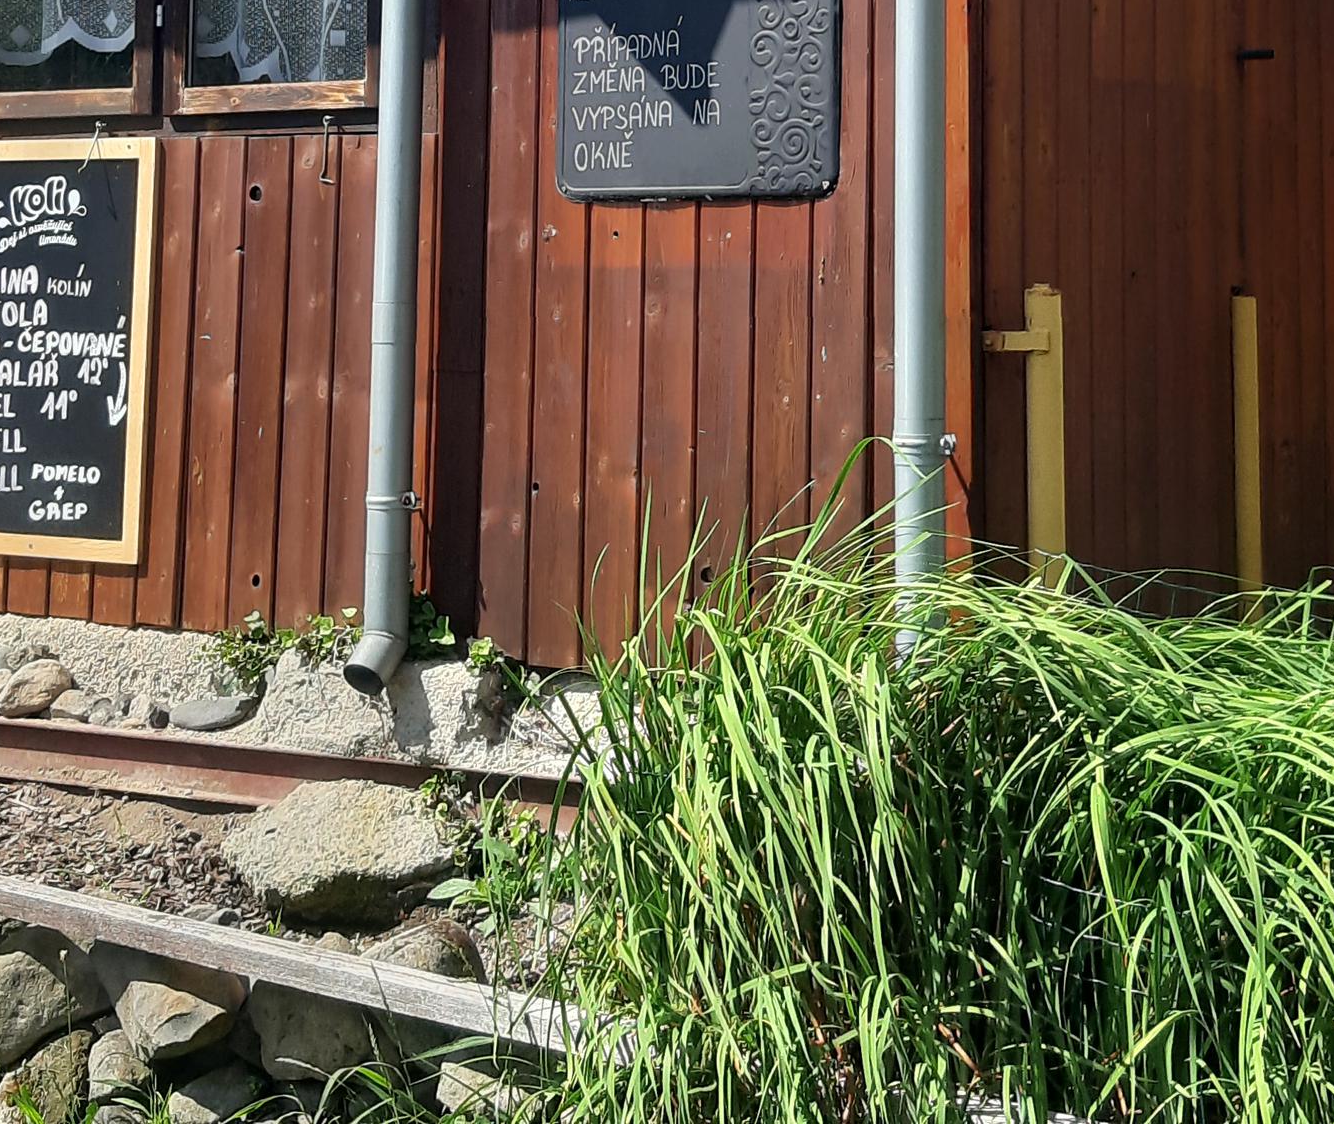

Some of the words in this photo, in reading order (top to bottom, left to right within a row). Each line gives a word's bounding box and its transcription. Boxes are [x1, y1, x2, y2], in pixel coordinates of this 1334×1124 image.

[572, 15, 683, 64] PŘÍPADNÁ
[572, 62, 645, 95] ZMĚNA
[660, 62, 720, 90] BUDE
[572, 95, 672, 131] VYPSÁNA
[693, 99, 720, 125] NA
[574, 131, 634, 171] OKNĚ
[47, 263, 92, 297] KOLÍN
[31, 463, 101, 485] POMELO
